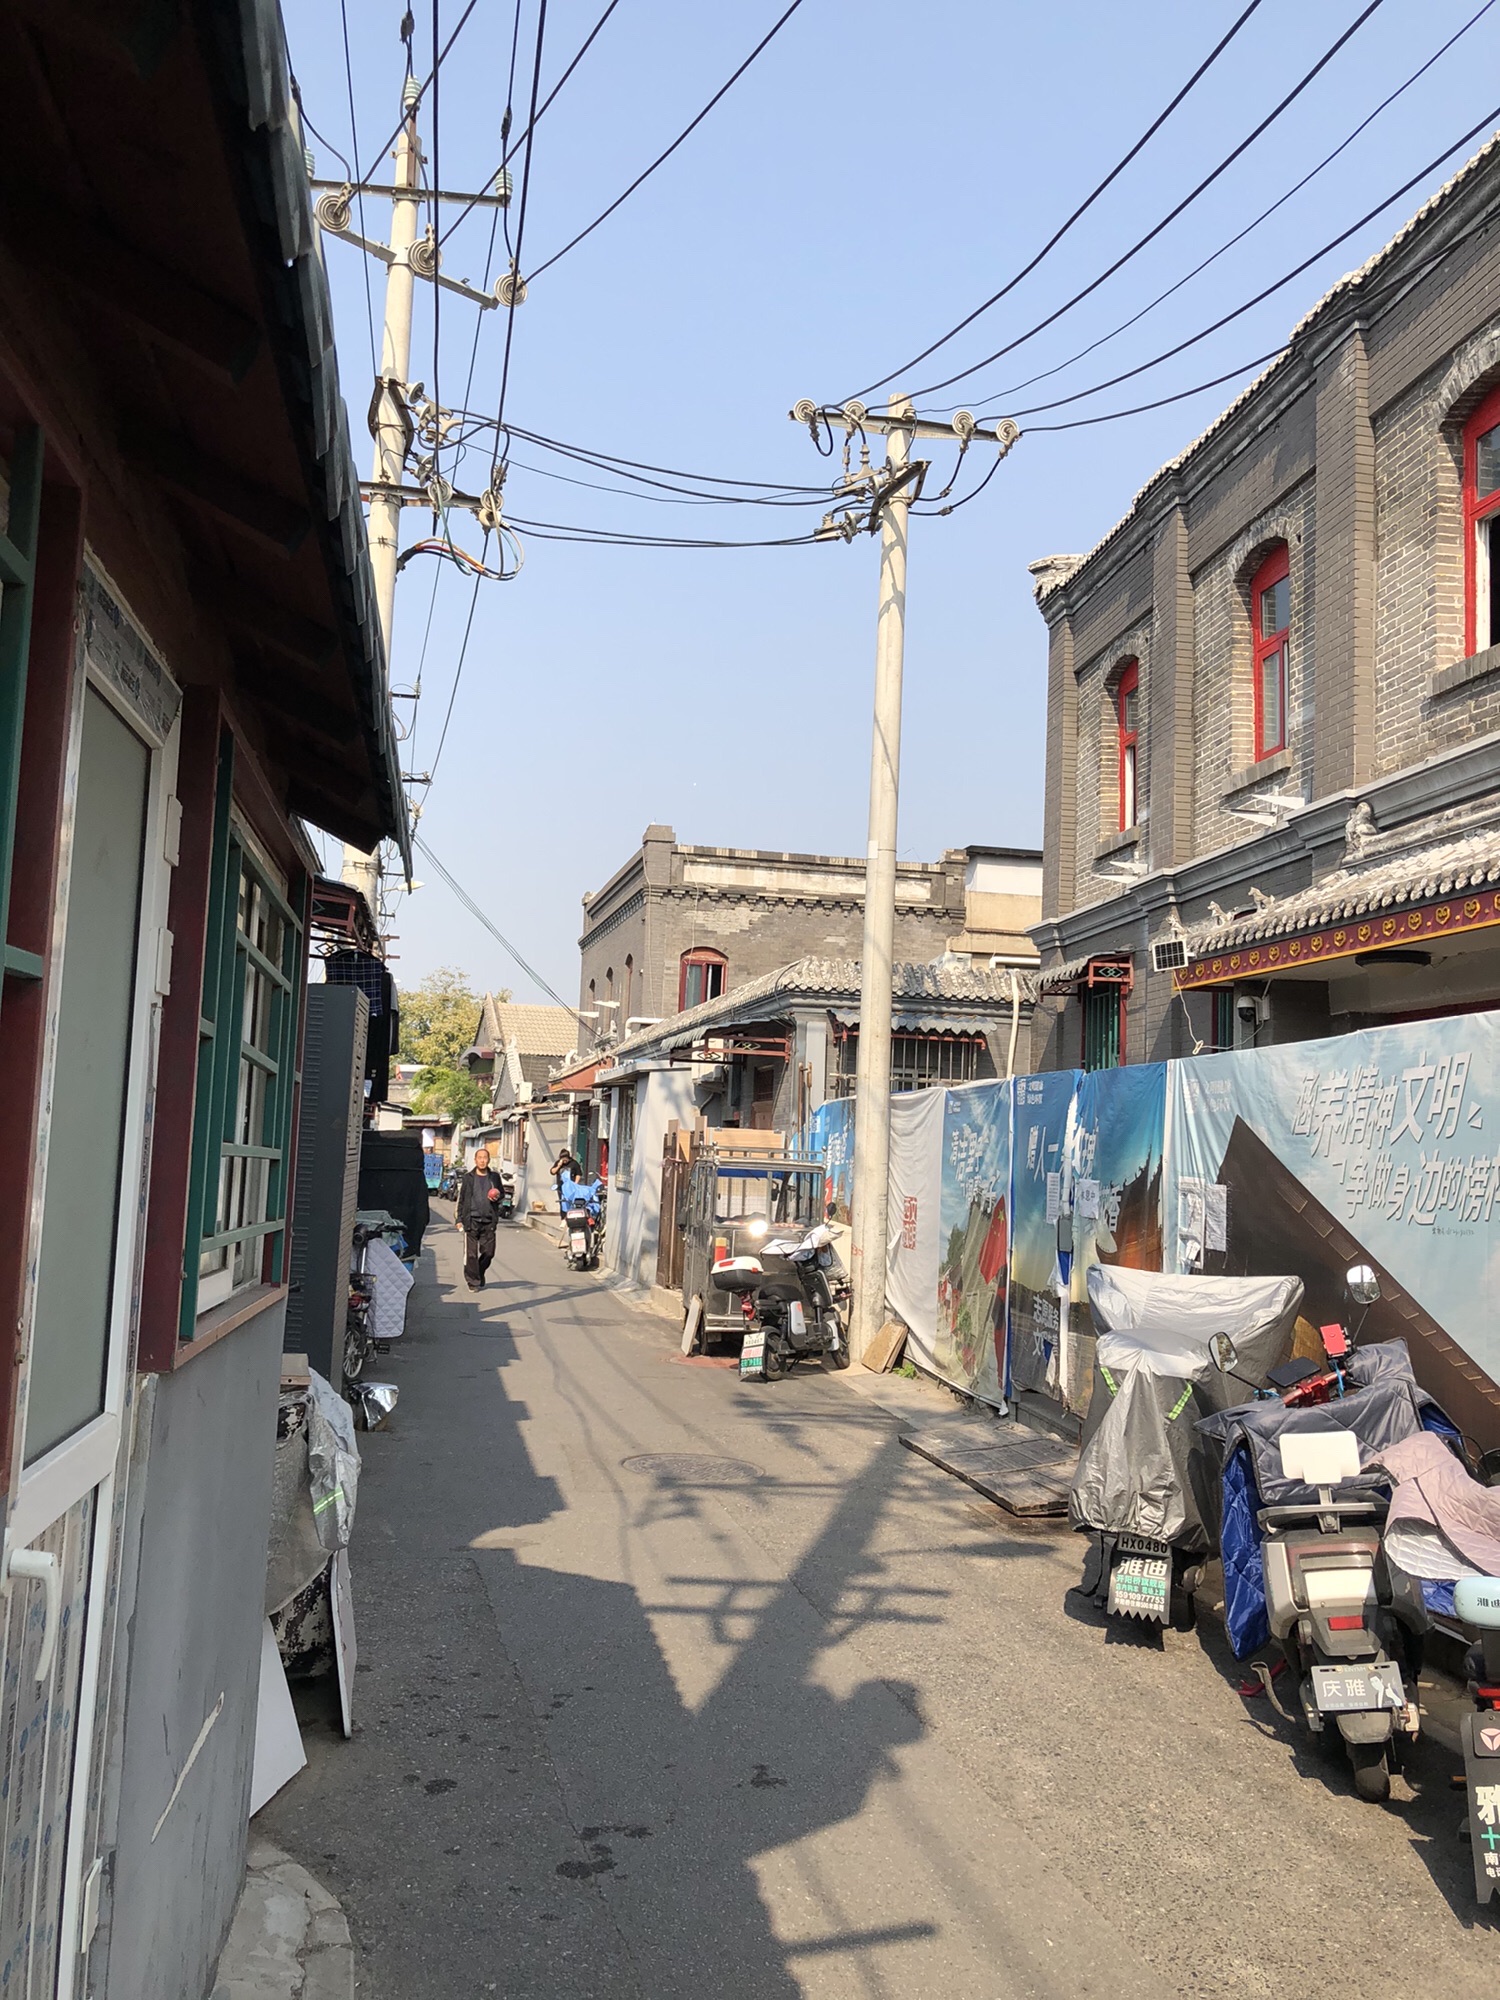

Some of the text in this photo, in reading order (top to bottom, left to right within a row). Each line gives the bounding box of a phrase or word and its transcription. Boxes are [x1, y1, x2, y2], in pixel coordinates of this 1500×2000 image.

[1292, 1051, 1472, 1157] 涵养精神文明
[1122, 1538, 1168, 1553] HX0480
[1117, 1557, 1167, 1580] 雅迪
[1115, 1591, 1165, 1604] 15910977753
